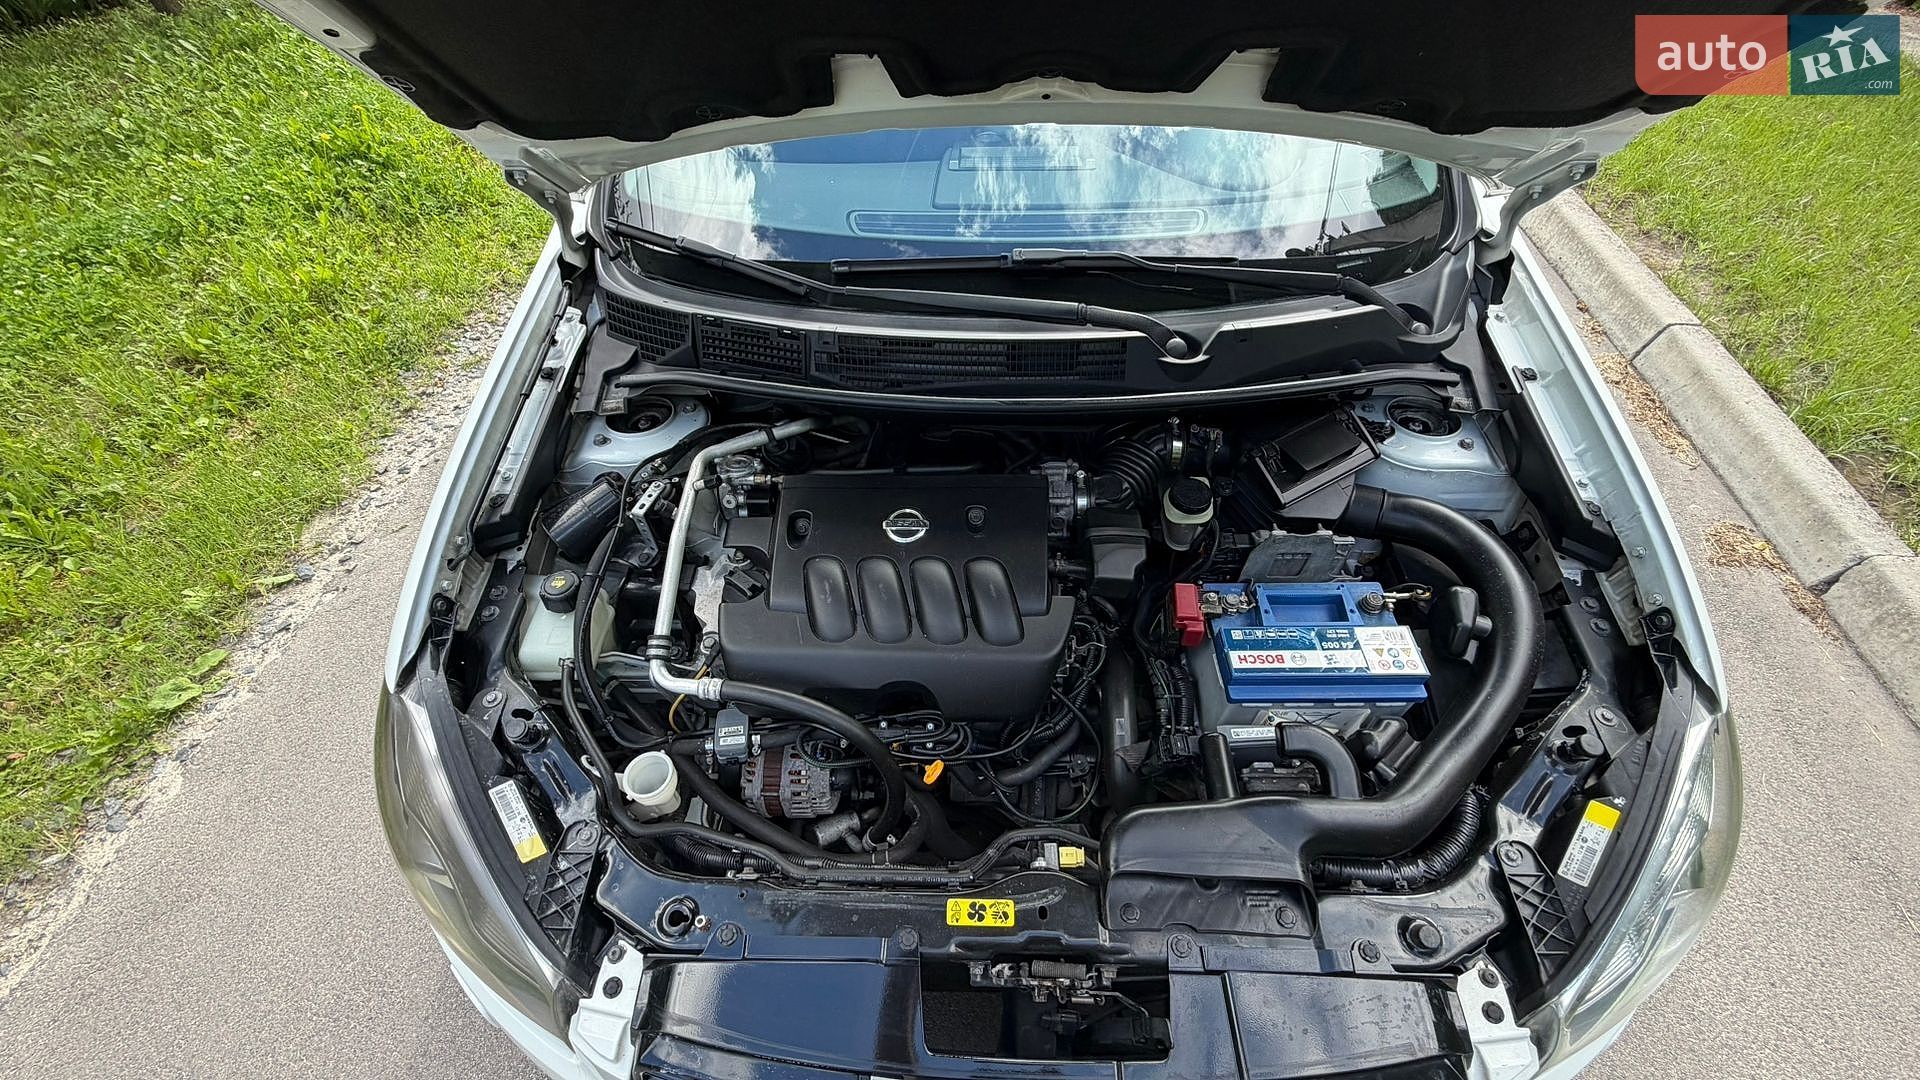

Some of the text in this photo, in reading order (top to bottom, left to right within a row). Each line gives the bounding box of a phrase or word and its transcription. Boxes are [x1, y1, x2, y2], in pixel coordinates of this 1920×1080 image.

[885, 519, 928, 528] NISSAN
[1322, 641, 1340, 650] 005
[1238, 654, 1285, 665] BOSCH
